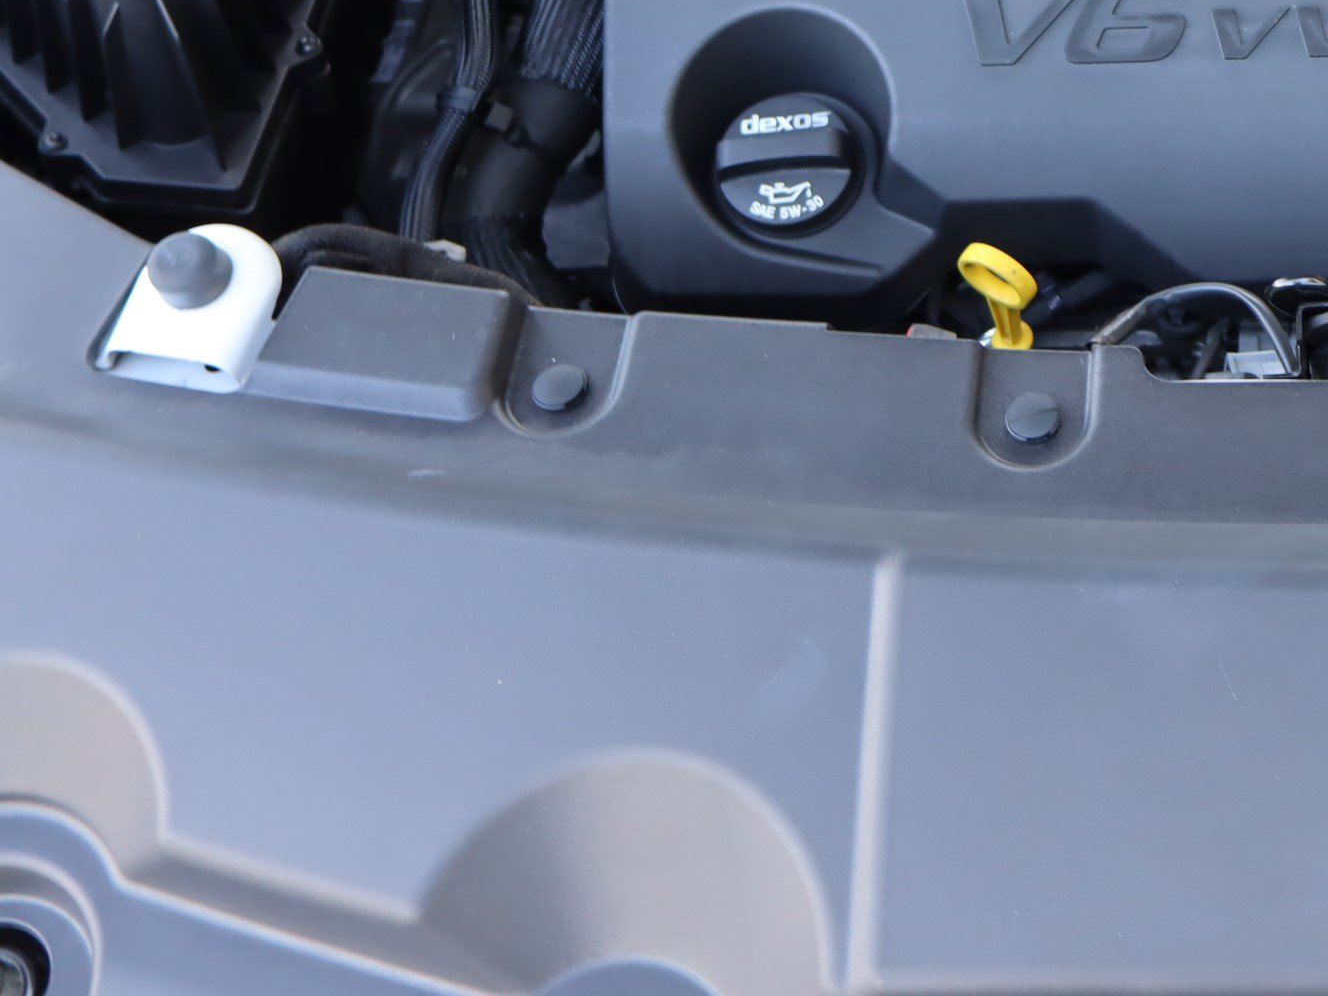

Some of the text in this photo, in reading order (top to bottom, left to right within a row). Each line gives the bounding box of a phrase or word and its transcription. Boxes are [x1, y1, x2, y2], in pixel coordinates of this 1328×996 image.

[740, 111, 831, 136] dexos
[750, 194, 825, 220] SAE 5W-30
